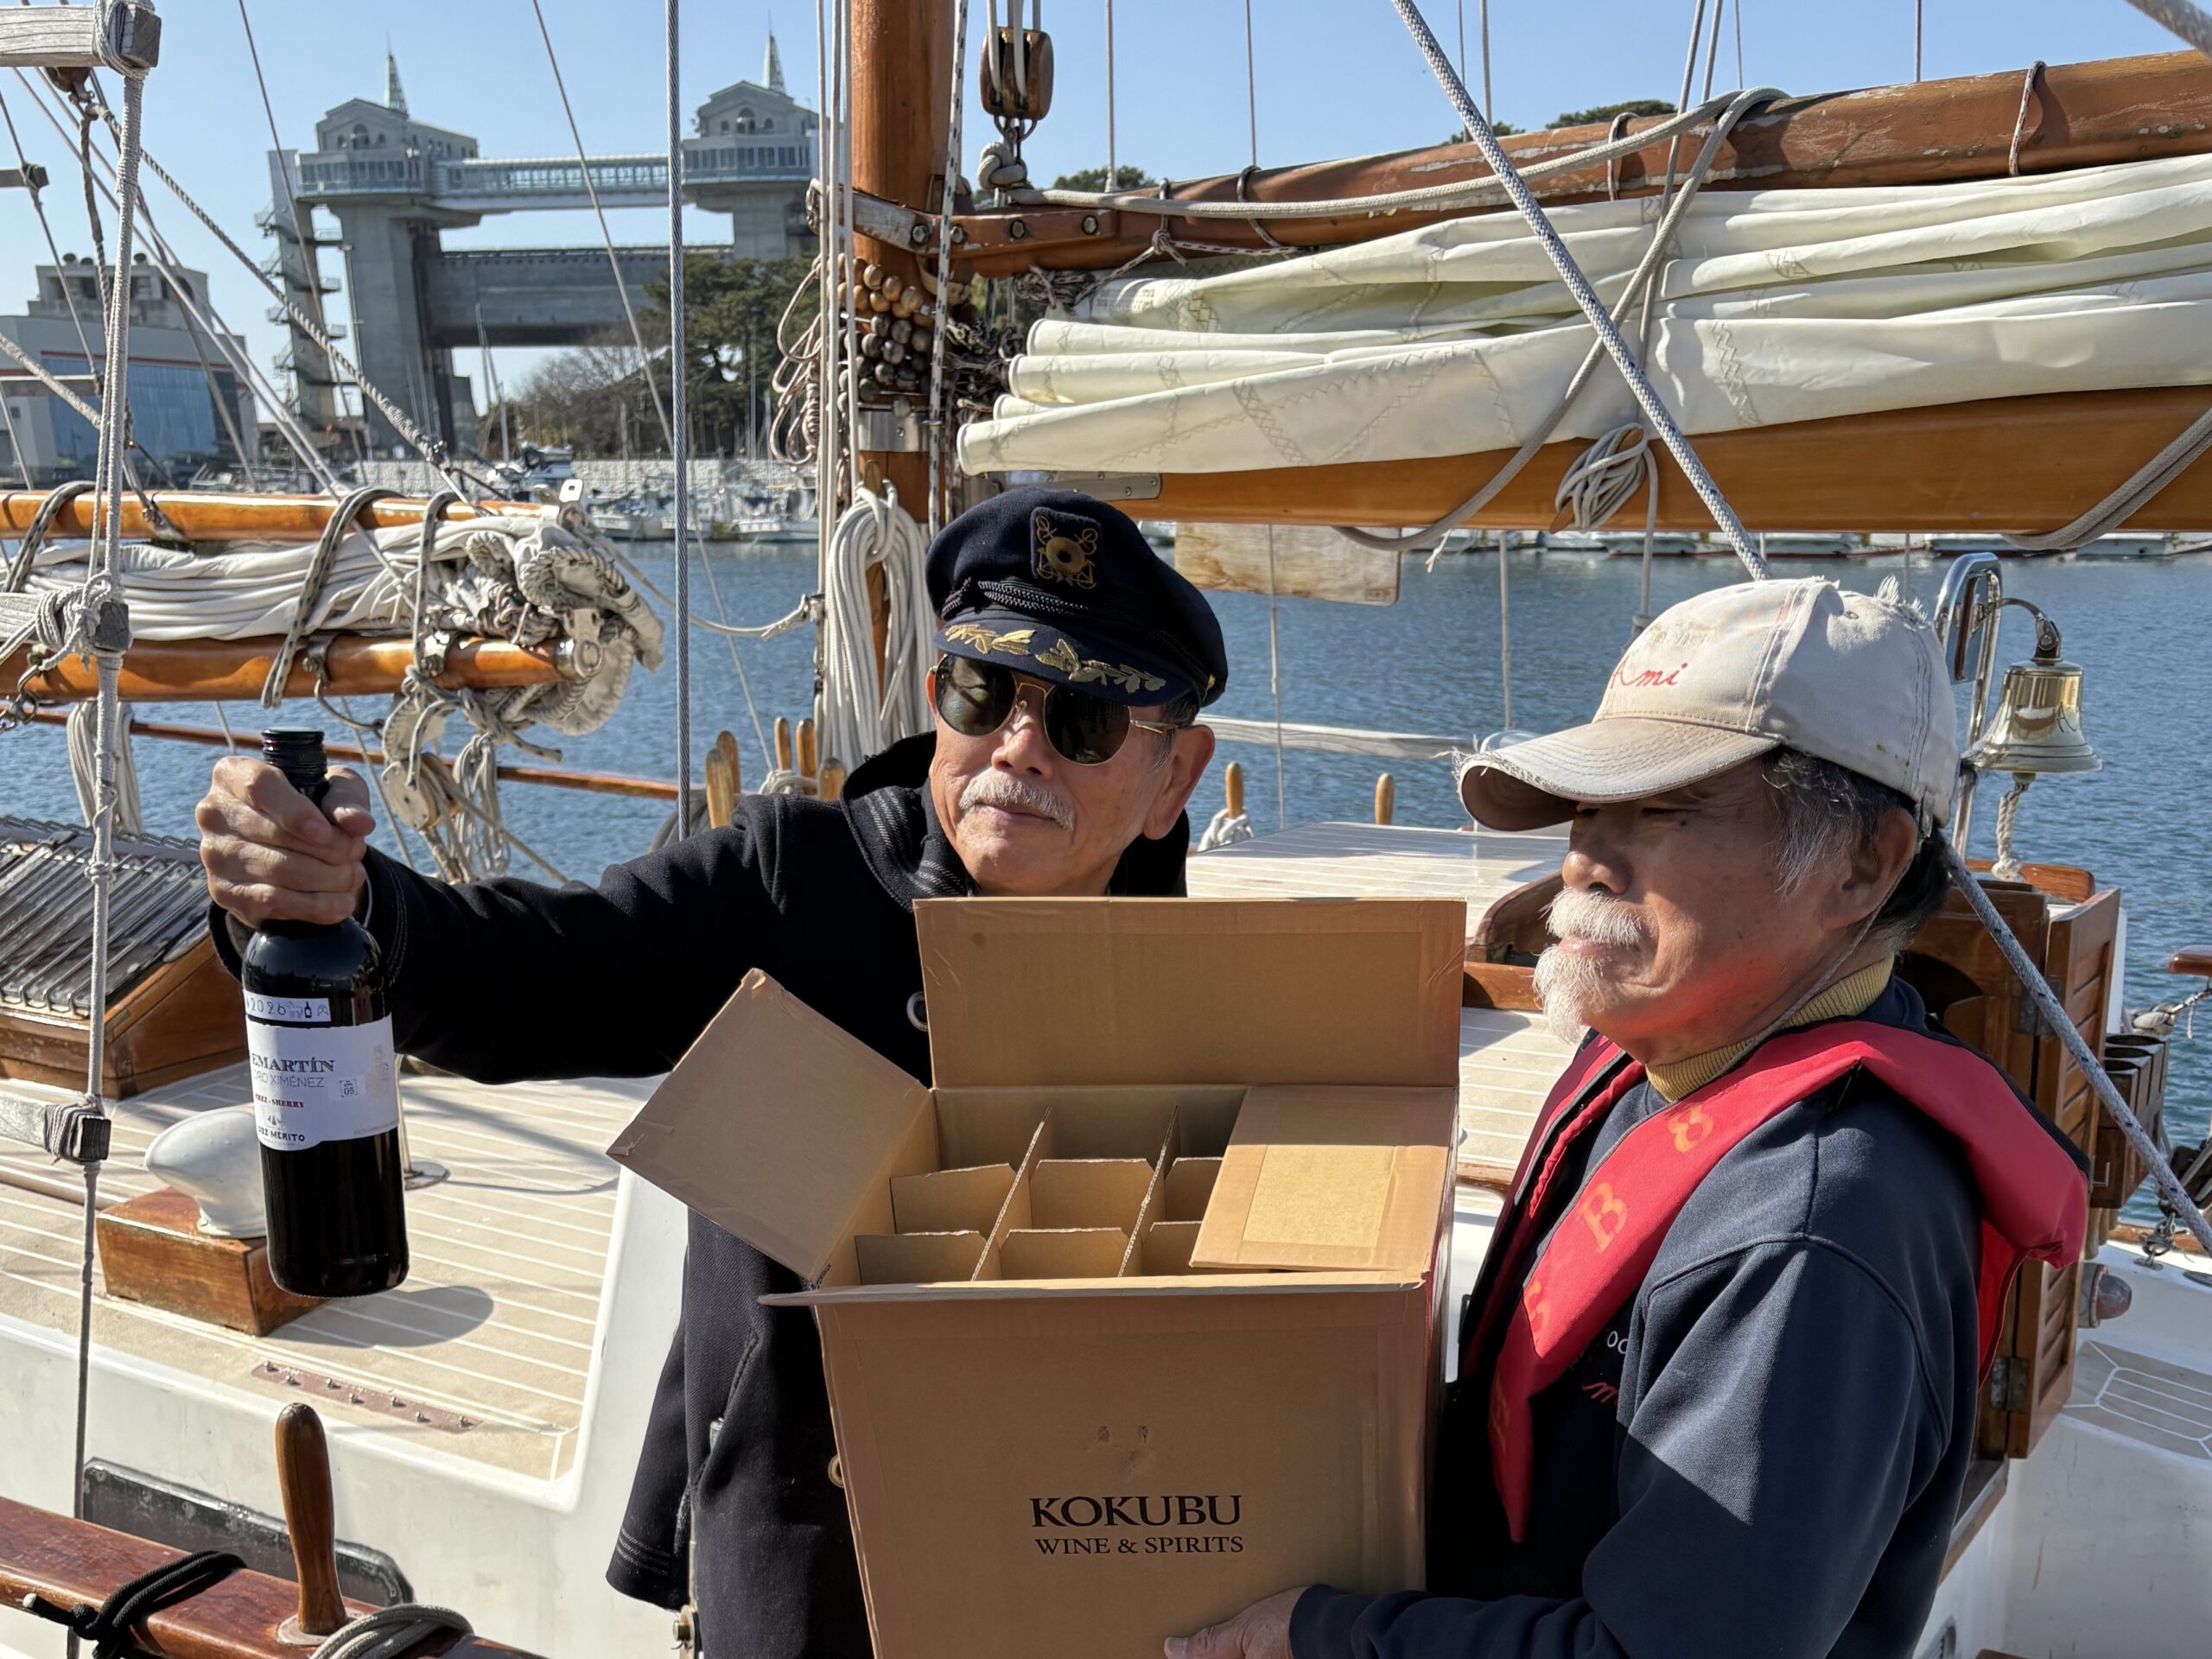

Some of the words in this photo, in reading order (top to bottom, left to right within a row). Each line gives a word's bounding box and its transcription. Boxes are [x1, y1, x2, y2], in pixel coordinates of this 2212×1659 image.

[1610, 654, 1688, 689] Ami
[271, 1098, 304, 1109] SHERRY
[270, 1130, 306, 1142] MERITO
[1029, 1495, 1243, 1528] KOKUBU
[1034, 1537, 1111, 1555] WINE
[1117, 1538, 1139, 1554] &
[1144, 1535, 1244, 1554] SPIRITS
